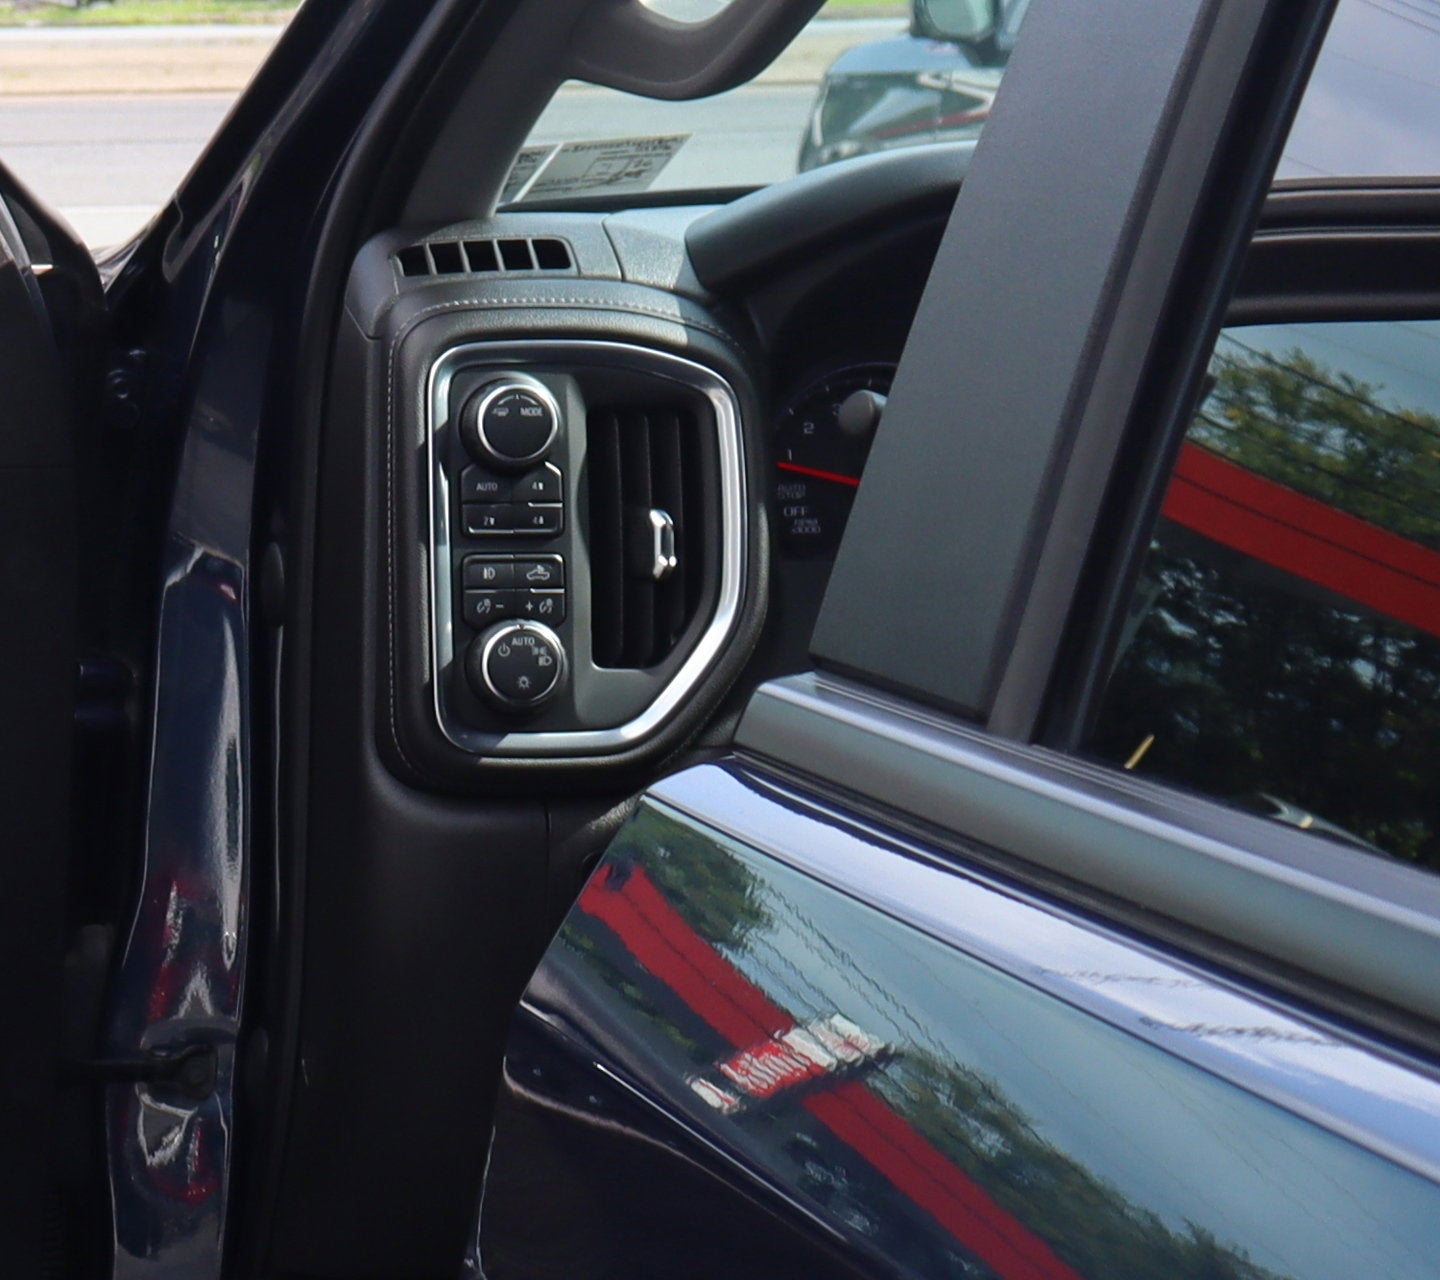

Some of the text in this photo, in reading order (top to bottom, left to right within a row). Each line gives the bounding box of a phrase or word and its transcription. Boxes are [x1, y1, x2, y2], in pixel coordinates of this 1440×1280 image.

[520, 407, 543, 417] MODE
[803, 422, 815, 435] 2
[476, 481, 498, 491] AUTO
[784, 506, 808, 517] OFF
[512, 637, 535, 647] AUTO
